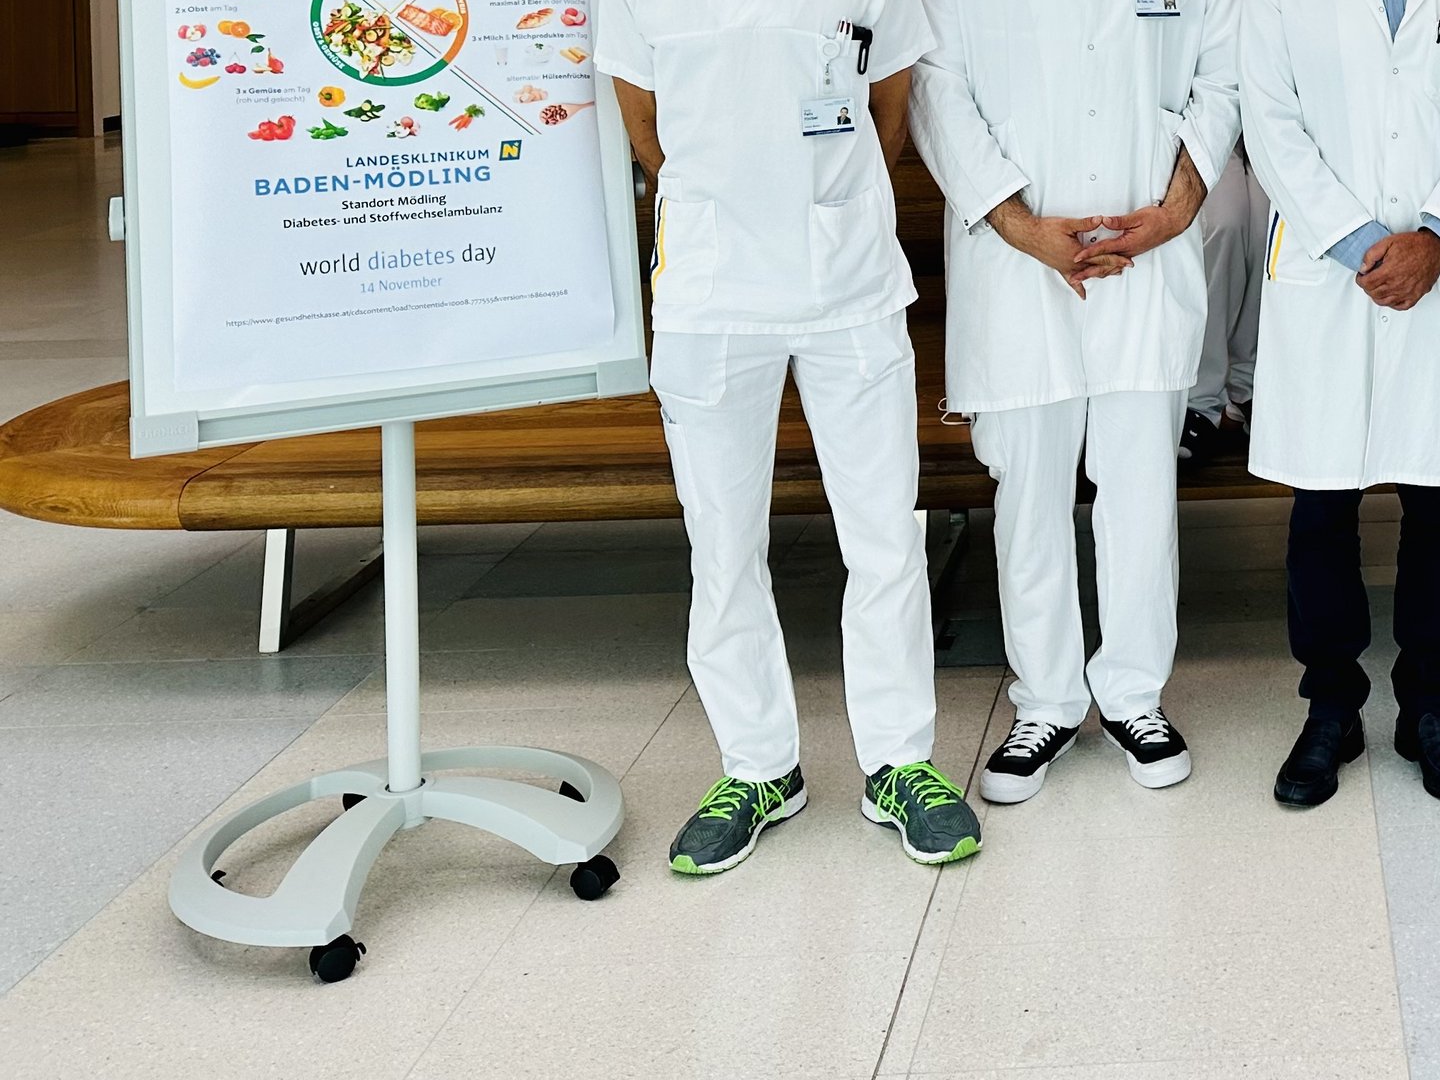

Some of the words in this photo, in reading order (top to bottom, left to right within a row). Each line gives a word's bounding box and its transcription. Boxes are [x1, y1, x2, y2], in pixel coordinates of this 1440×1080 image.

[187, 5, 208, 13] Obst
[224, 5, 238, 13] Tag
[511, 32, 565, 41] Milchprodukte
[248, 86, 282, 95] Gemüse
[298, 86, 311, 94] Tag
[346, 149, 490, 168] LANDESKLINIKUM
[254, 165, 491, 196] BADEN-MÖDLING
[341, 197, 395, 210] Standort
[397, 194, 447, 206] Mödling
[283, 217, 341, 229] Diabetes-
[343, 214, 367, 225] und
[369, 205, 503, 224] Stoffwechselambulanz
[300, 252, 361, 276] world
[368, 248, 455, 271] diabetes
[461, 243, 497, 265] day
[360, 282, 375, 294] 14
[378, 276, 443, 292] November
